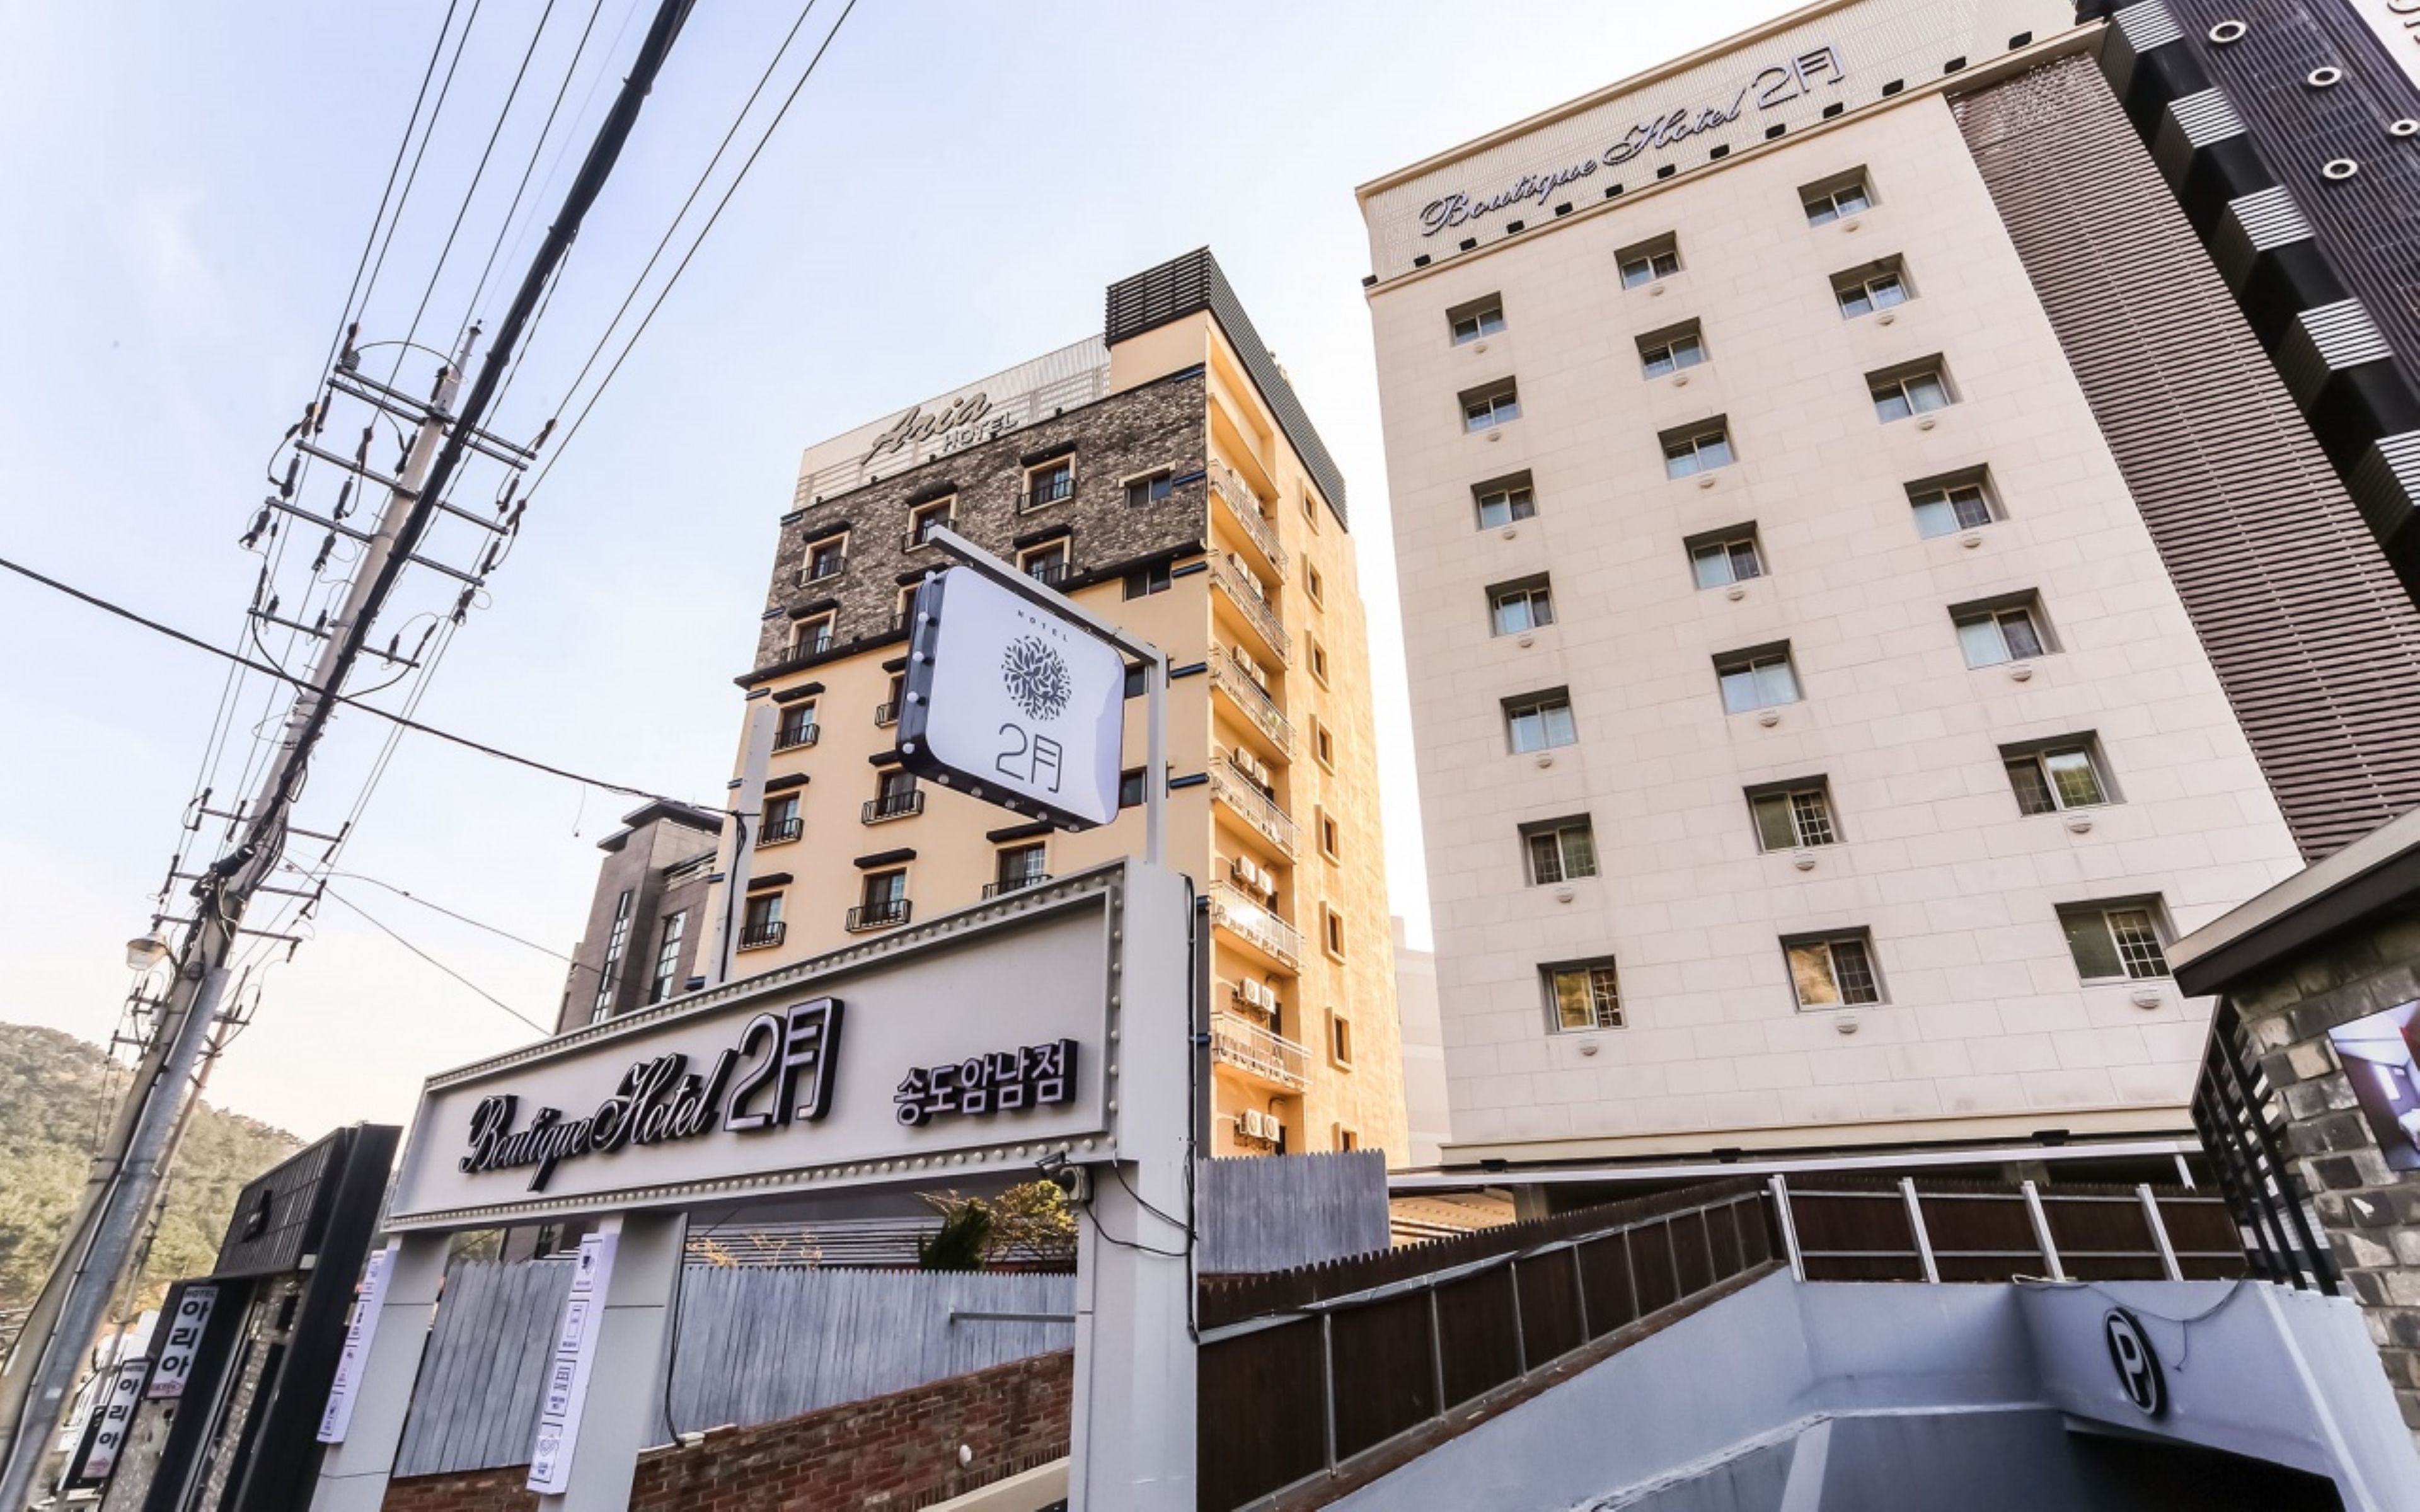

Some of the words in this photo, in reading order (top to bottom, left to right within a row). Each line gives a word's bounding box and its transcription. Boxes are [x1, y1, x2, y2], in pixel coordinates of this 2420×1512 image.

[1419, 156, 1598, 236] Boutique
[1602, 87, 1747, 166] Hotel
[861, 392, 993, 466] Aria
[943, 411, 1019, 452] HOTEL
[1017, 609, 1068, 642] HOTEL
[459, 1094, 591, 1192] Boutique
[588, 1048, 742, 1152] Hotel
[893, 1038, 1078, 1126] 송도암남점
[161, 1300, 210, 1378] 아리아
[2109, 1320, 2143, 1402] P
[99, 1378, 139, 1450] 아리아
